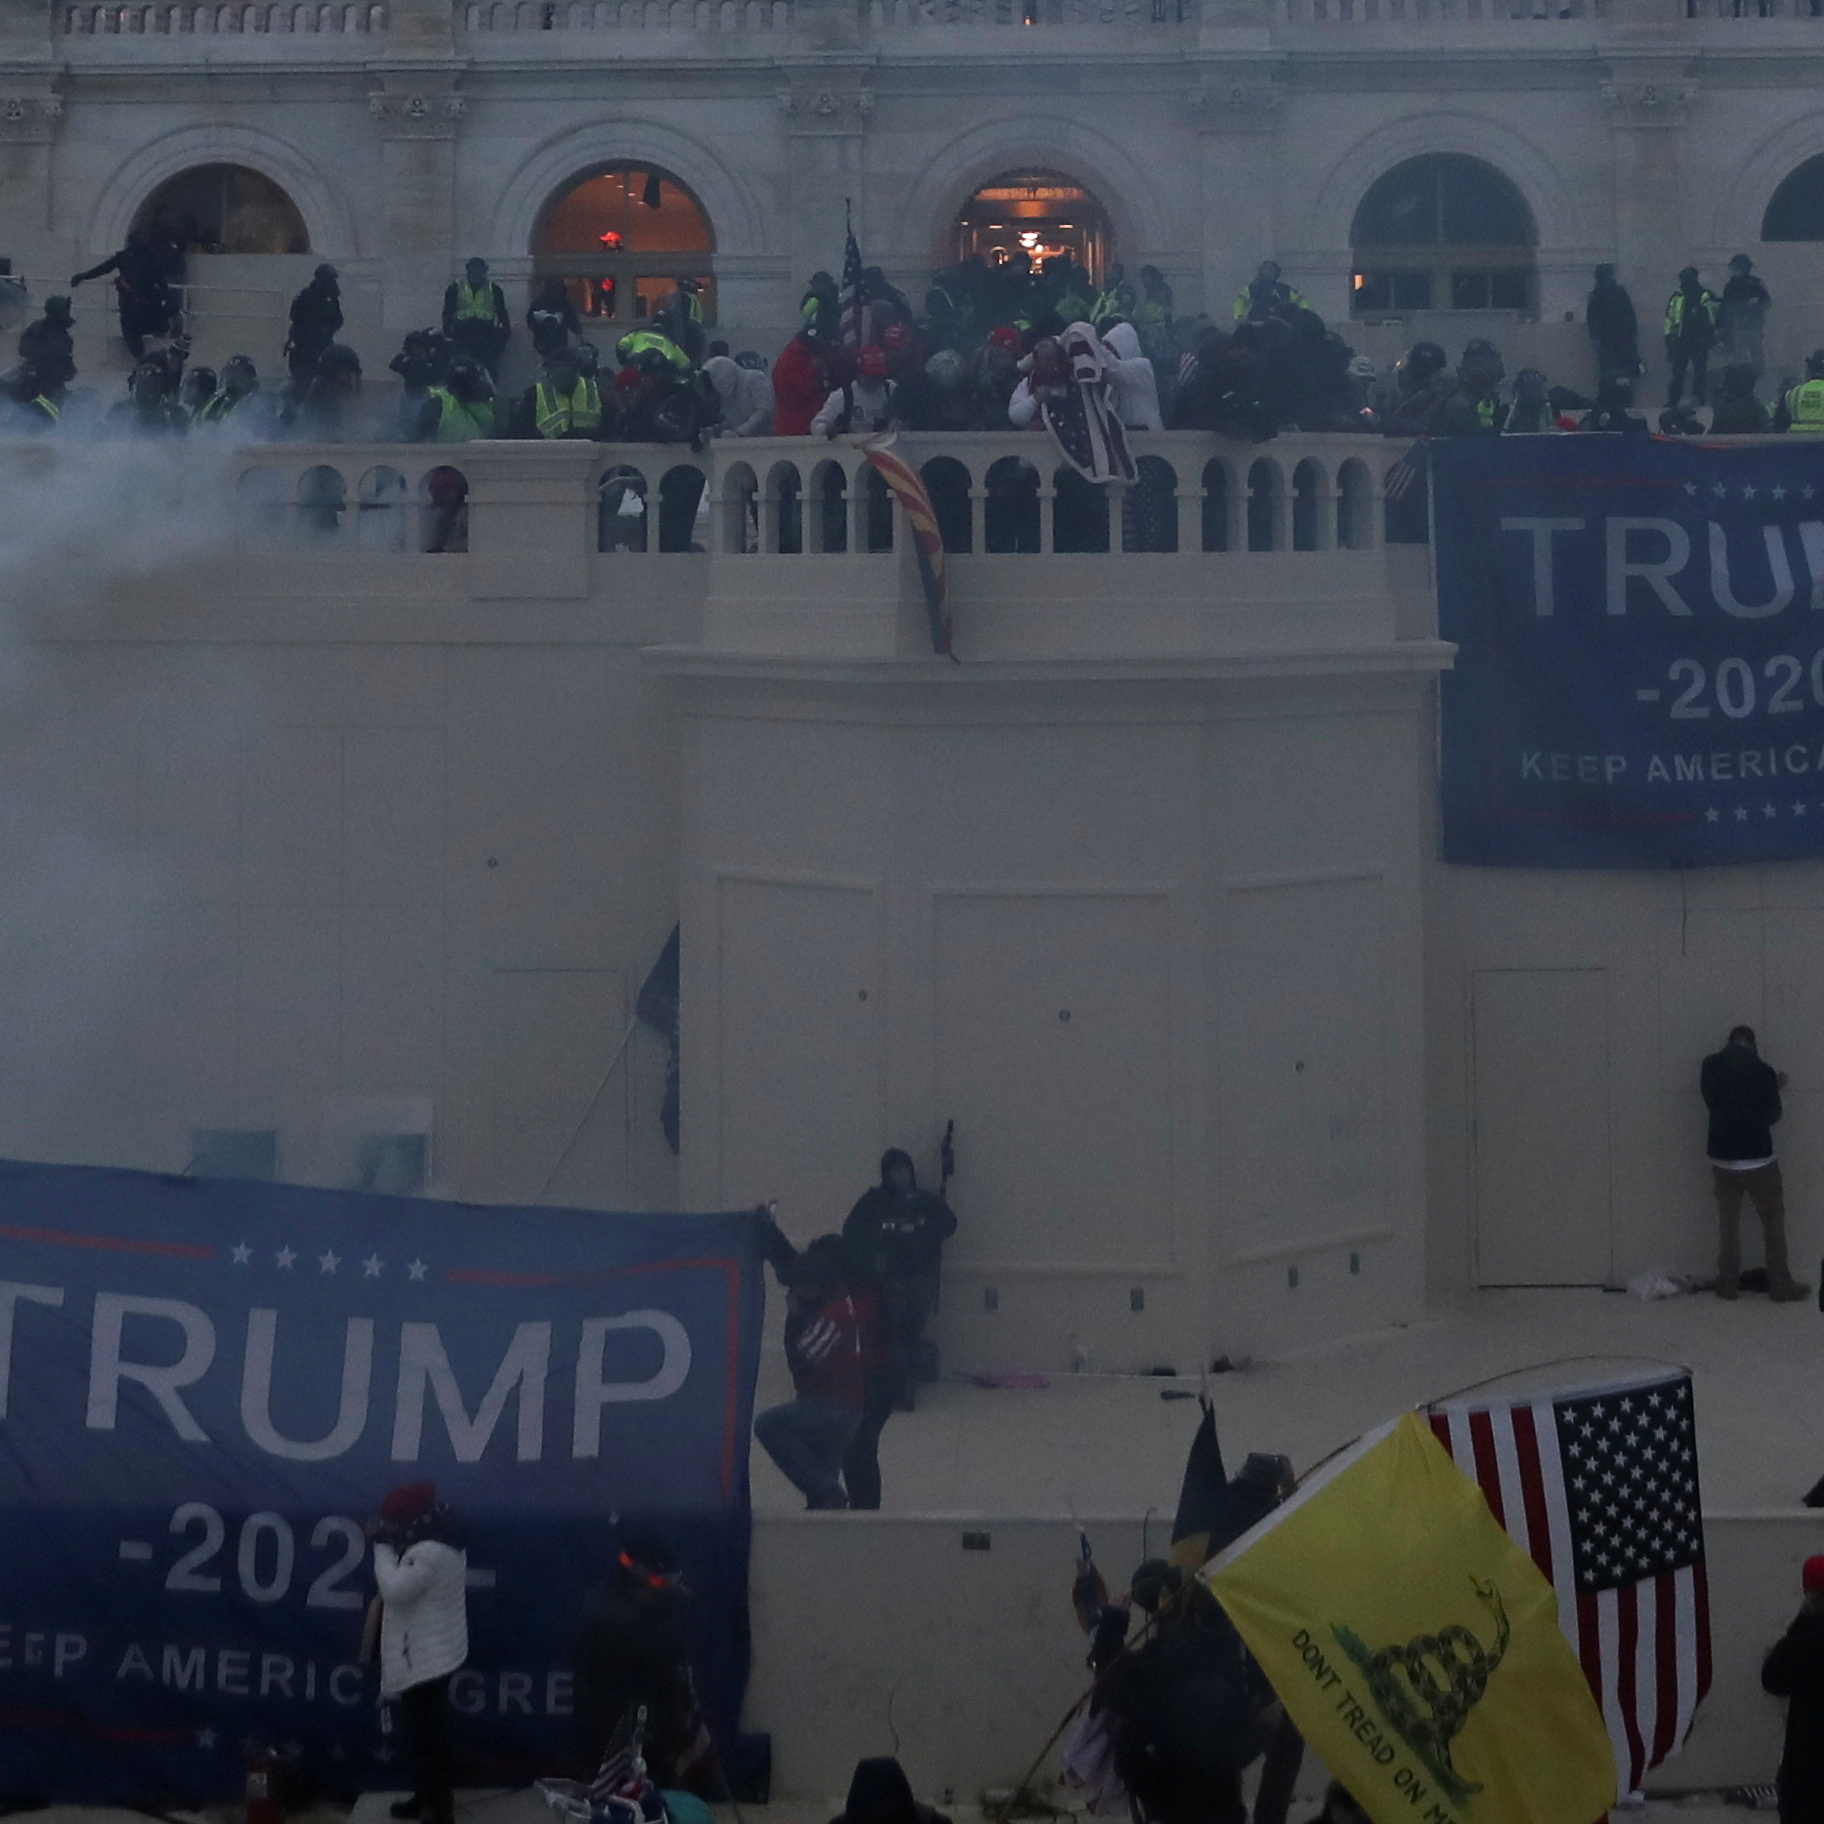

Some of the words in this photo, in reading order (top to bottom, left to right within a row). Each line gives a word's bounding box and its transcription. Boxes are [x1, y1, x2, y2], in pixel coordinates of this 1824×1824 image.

[1521, 751, 1628, 784] KEEP
[119, 1500, 496, 1609] -202-
[116, 1642, 388, 1707] AMERIC
[447, 1670, 574, 1716] GRE
[1336, 1690, 1395, 1765] TREAD
[1393, 1767, 1427, 1804] ON
